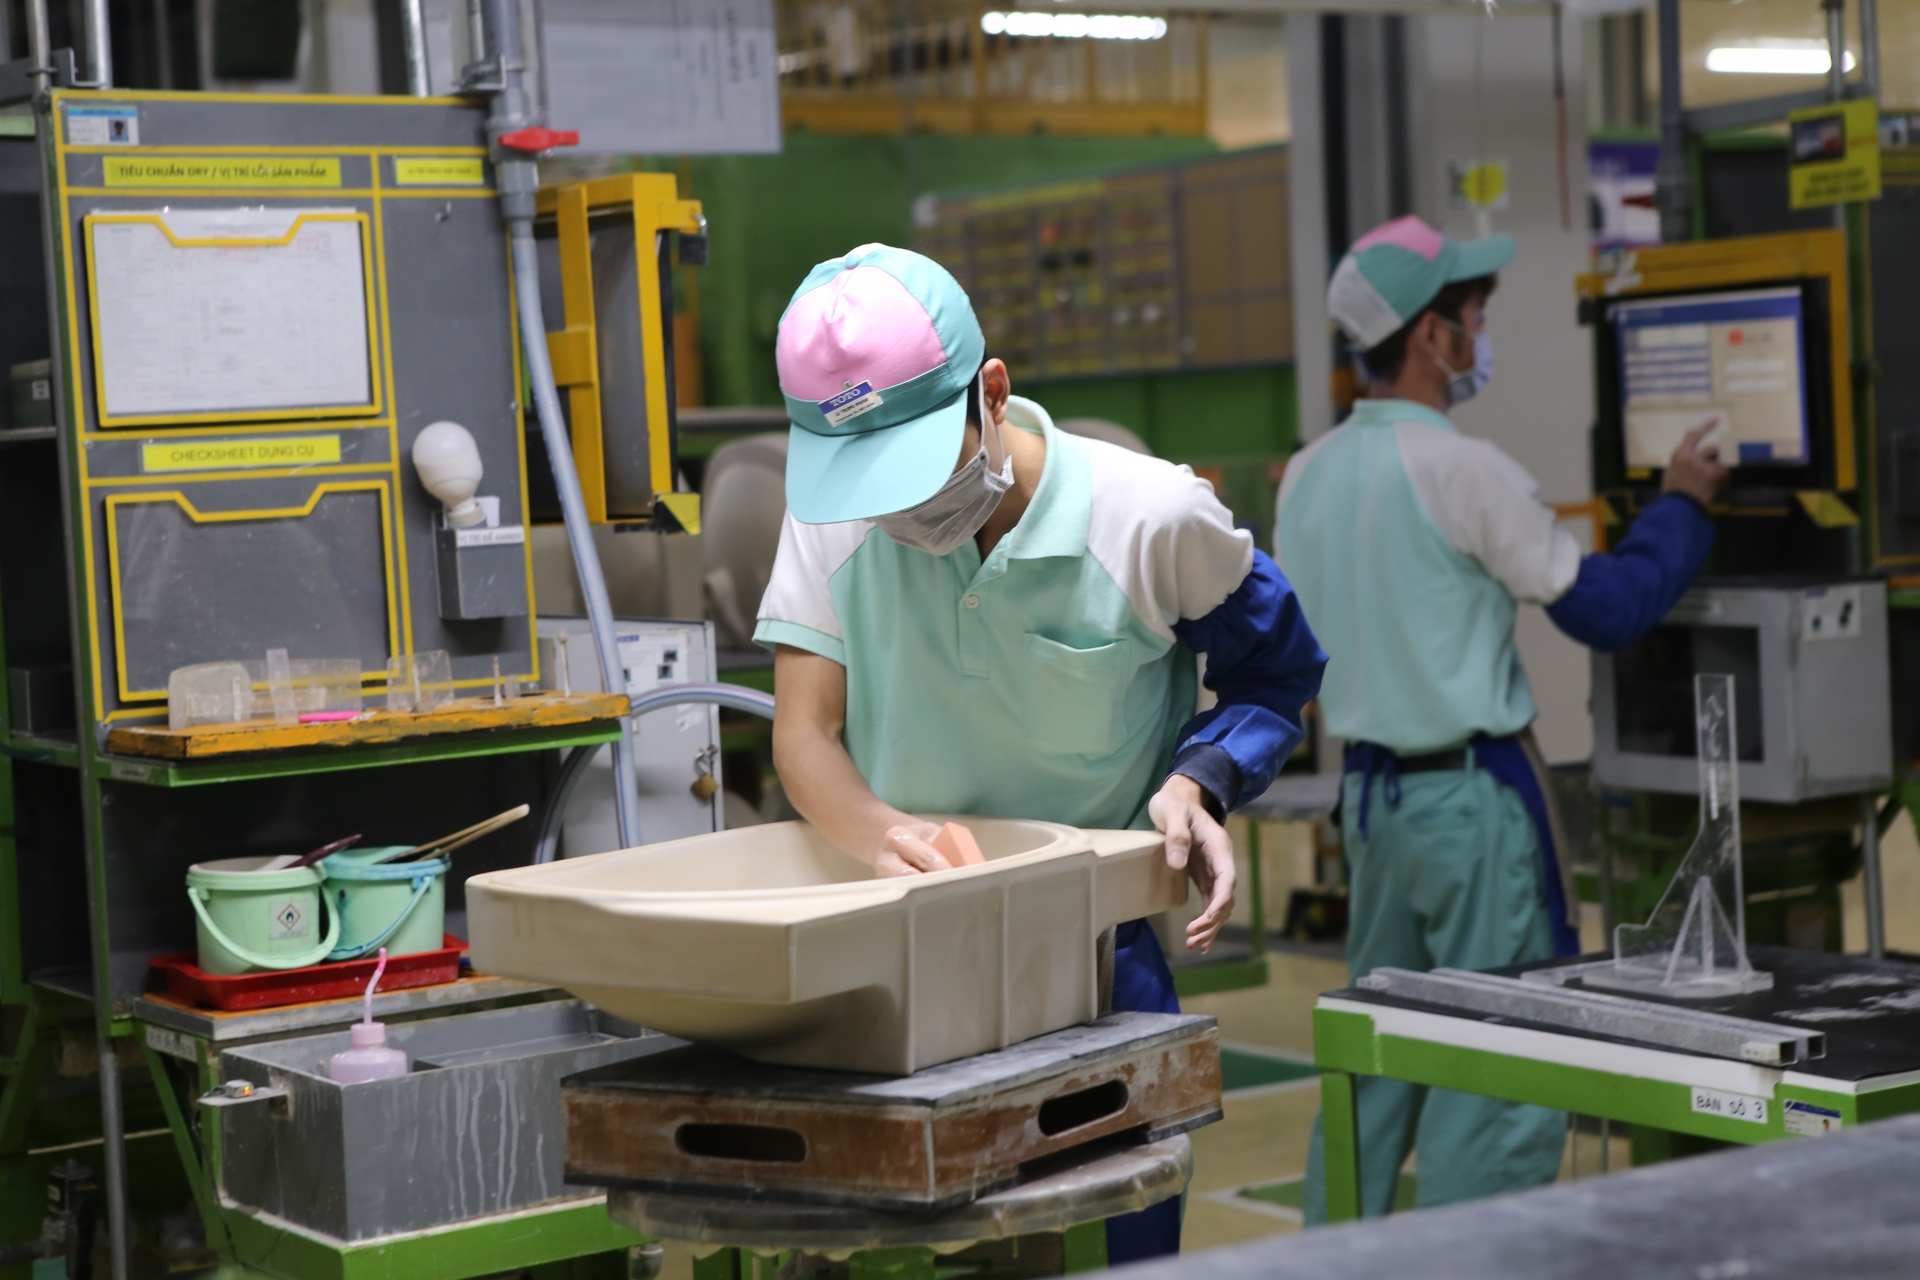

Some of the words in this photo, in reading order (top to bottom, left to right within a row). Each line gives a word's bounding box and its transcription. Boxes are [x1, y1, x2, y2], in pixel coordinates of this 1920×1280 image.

[829, 388, 861, 407] TOTO
[171, 446, 254, 463] CHECKSHEET
[1753, 1101, 1763, 1119] 3
